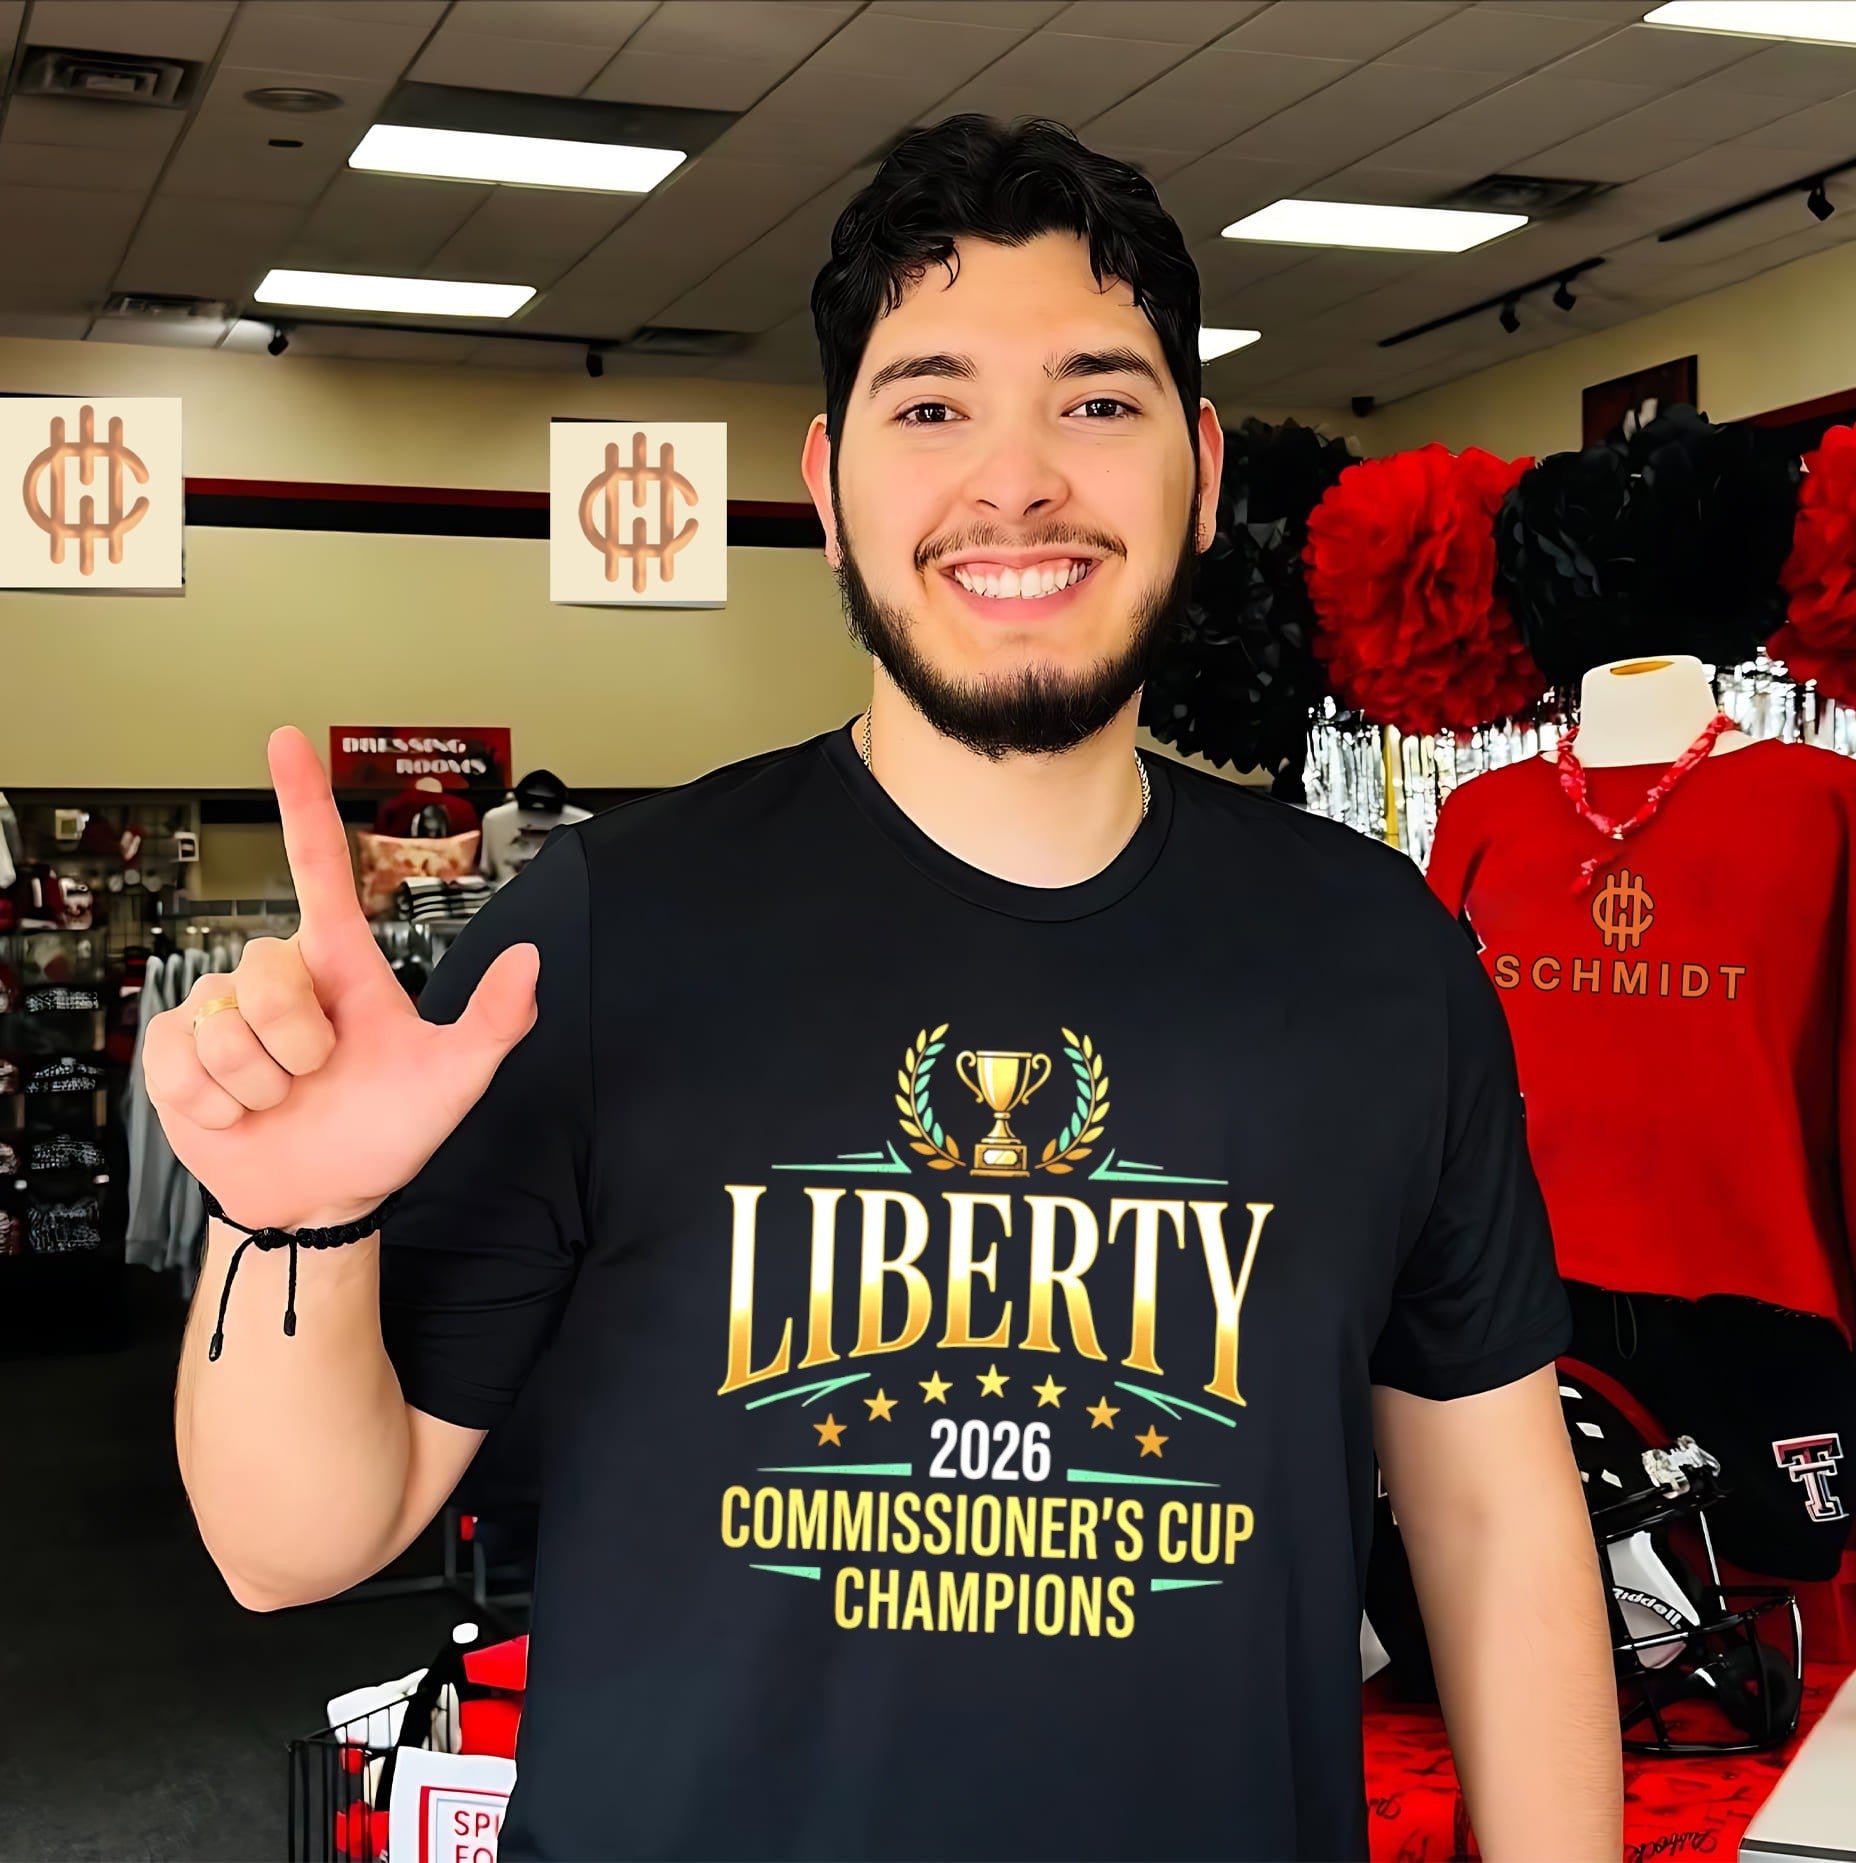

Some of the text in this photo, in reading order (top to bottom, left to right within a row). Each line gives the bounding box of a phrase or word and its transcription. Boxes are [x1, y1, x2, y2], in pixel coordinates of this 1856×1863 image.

[342, 737, 467, 754] DRESSING
[396, 758, 487, 776] ROOMS
[1494, 954, 1746, 1000] SCHMIDT
[717, 1184, 1275, 1407] LIBERTY
[929, 1418, 1052, 1482] 2026
[720, 1485, 1255, 1565] COMMISSIONER'S CUP
[834, 1566, 1136, 1638] CHAMPIONS
